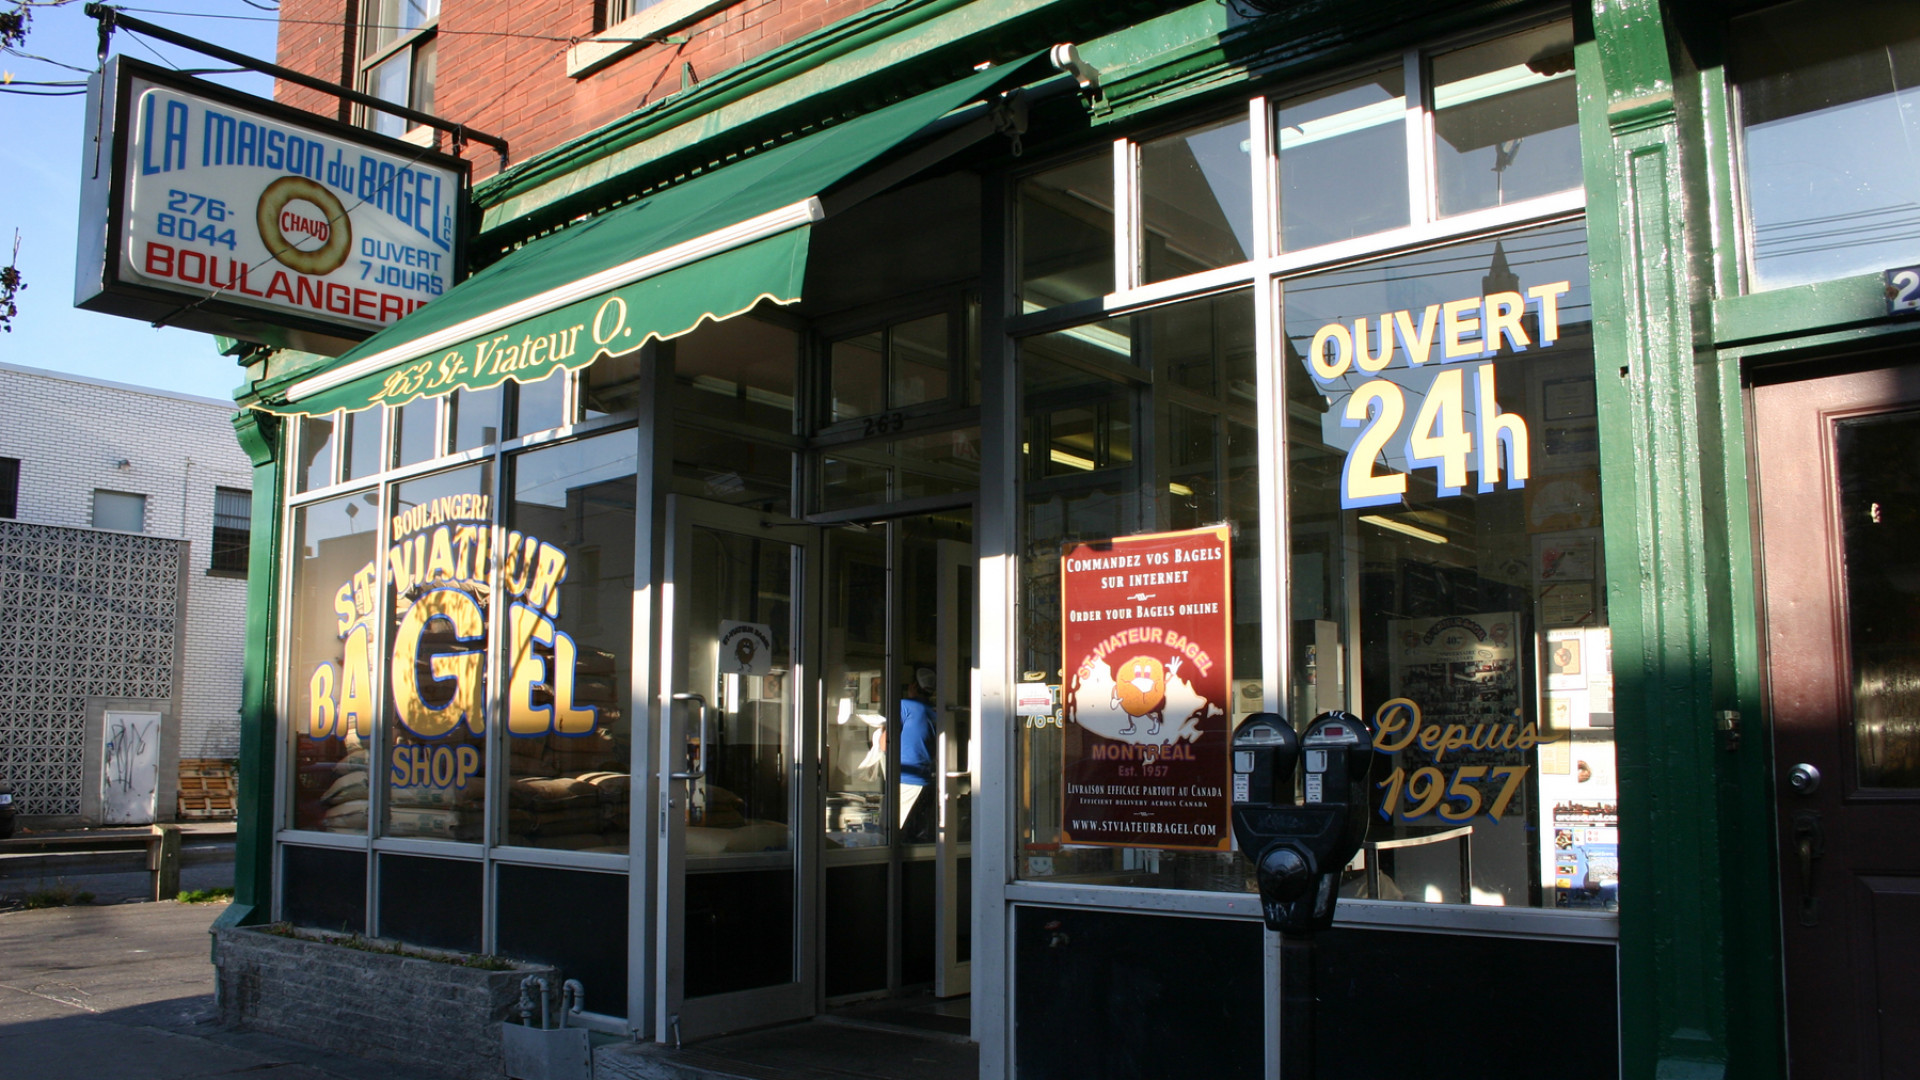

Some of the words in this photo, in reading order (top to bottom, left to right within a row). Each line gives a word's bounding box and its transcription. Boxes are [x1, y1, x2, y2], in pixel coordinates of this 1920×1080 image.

[143, 93, 189, 176] LA
[202, 110, 325, 182] MAISON
[327, 149, 354, 195] du
[358, 155, 450, 253] BAGEL
[168, 189, 235, 222] 276-
[157, 213, 237, 251] 8044
[281, 211, 329, 242] CHAUD
[362, 237, 442, 272] OUVERT
[145, 241, 428, 323] BOULANGERI
[360, 261, 372, 280] 7
[374, 264, 444, 296] JOURS
[426, 324, 585, 390] St-Viateur
[592, 296, 632, 345] O.
[1307, 280, 1570, 384] OUVERT
[1340, 363, 1531, 510] 24h
[1066, 557, 1142, 573] COMMANDEZ
[1146, 552, 1170, 565] VOS
[1174, 547, 1222, 563] BAGELS
[1101, 576, 1125, 589] SUR
[1129, 571, 1189, 587] INTERNET
[1069, 610, 1102, 622] ORDER
[1105, 608, 1133, 620] YOUR
[1136, 605, 1175, 619] BAGELS
[1179, 602, 1219, 615] ONLINE
[309, 587, 599, 740] BAGEL
[1077, 626, 1163, 680] ST-VIATEUR
[1164, 630, 1213, 678] BAGEL
[1372, 698, 1565, 763] Depuis
[390, 744, 481, 790] SHOP
[1091, 738, 1197, 761] MONTRÉAL
[1118, 765, 1138, 777] Est.
[1142, 765, 1169, 777] 1957
[1067, 782, 1104, 795] LIVRAISON
[1107, 785, 1140, 796] EFFICACE
[1143, 786, 1175, 796] PARTOUT
[1178, 787, 1189, 796] AU
[1191, 784, 1222, 797] CANADA
[1179, 800, 1208, 808] CANADA
[1376, 766, 1531, 825] 1957
[1072, 819, 1216, 836] WWW.STVIATEURBAGEL.COM
